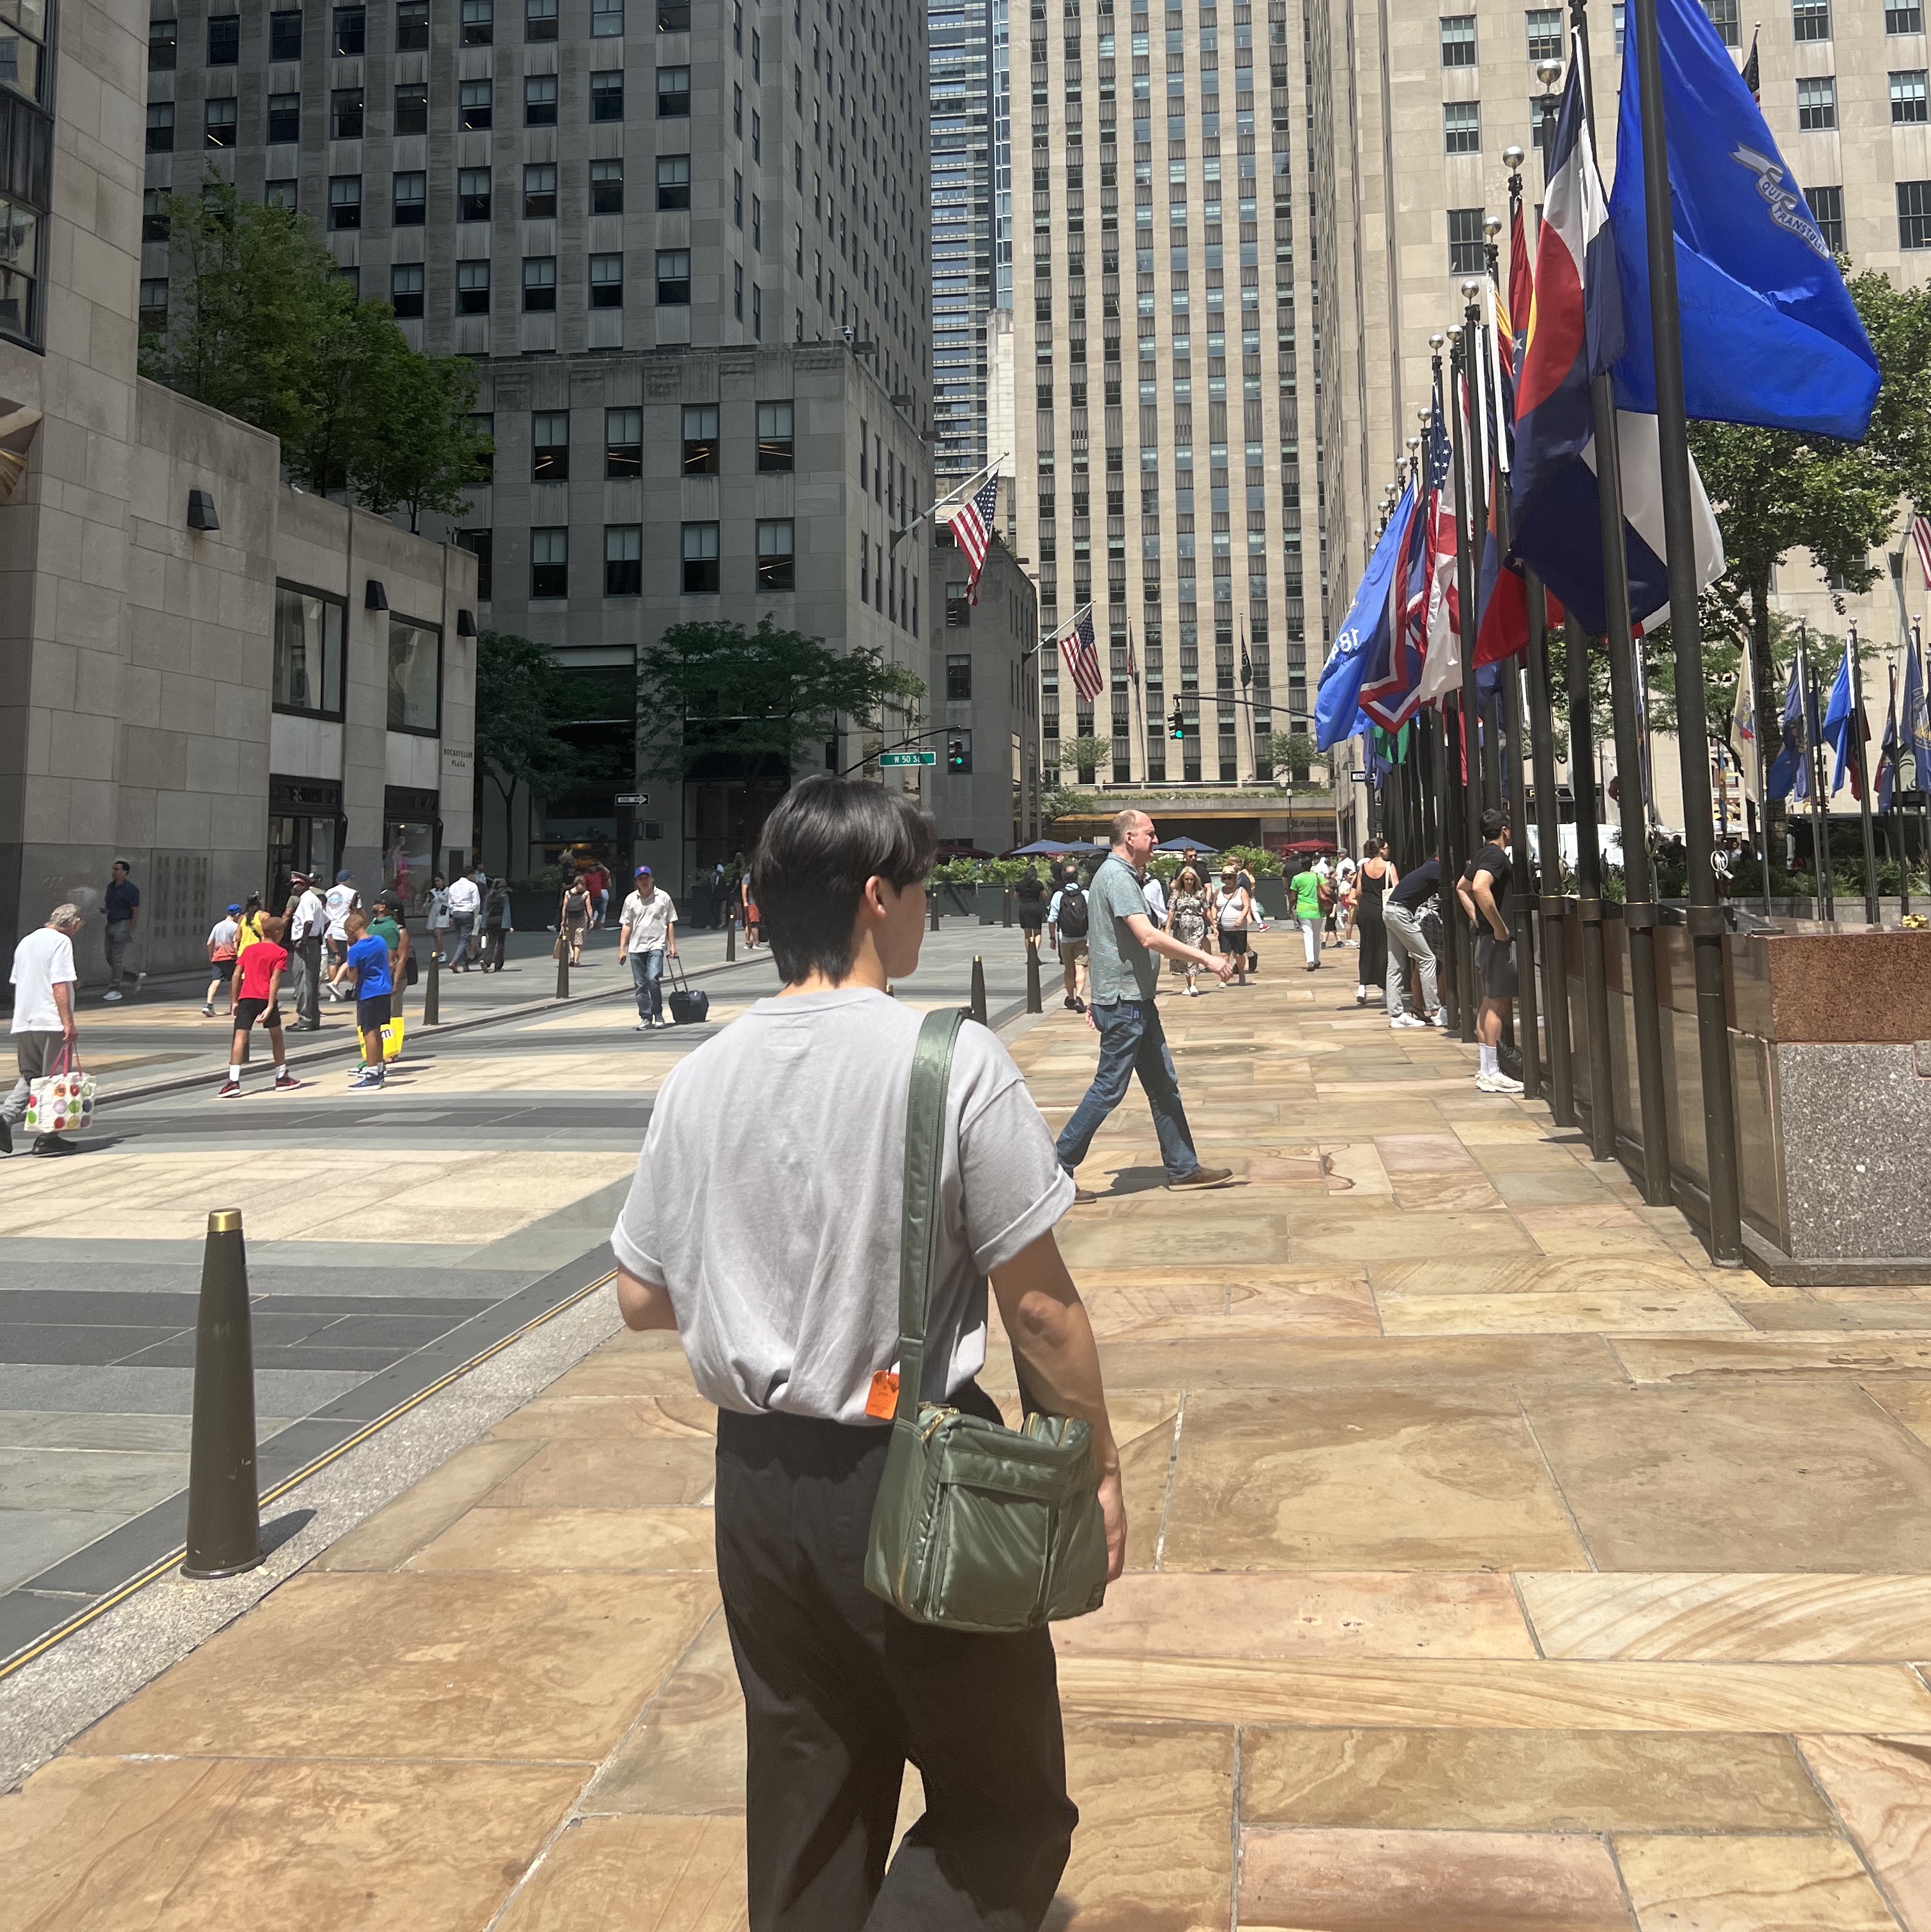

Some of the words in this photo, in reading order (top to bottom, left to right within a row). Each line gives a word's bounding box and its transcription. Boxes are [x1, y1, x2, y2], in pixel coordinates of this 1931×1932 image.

[1762, 181, 1781, 200] QUI
[1773, 206, 1826, 252] TRANSTULIT
[444, 747, 473, 758] ROCKEFELLER
[894, 755, 899, 763] W
[901, 755, 911, 763] 50
